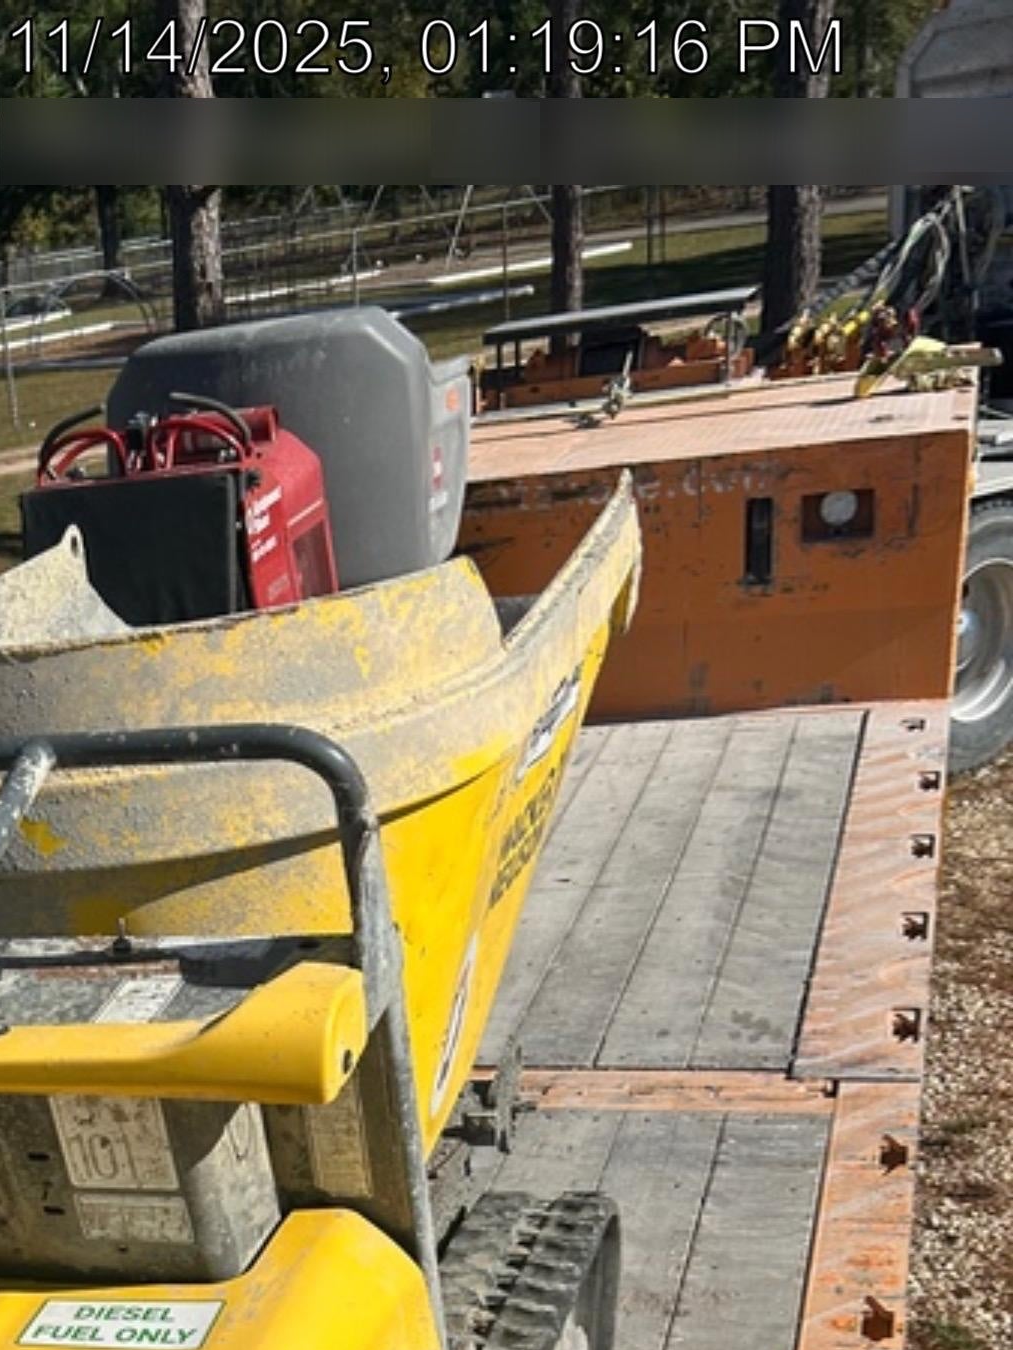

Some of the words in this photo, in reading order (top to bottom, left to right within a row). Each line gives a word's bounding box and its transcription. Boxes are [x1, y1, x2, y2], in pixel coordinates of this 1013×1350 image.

[73, 1304, 176, 1322] DIESEL
[31, 1324, 106, 1342] FUEL
[114, 1326, 198, 1345] ONLY
